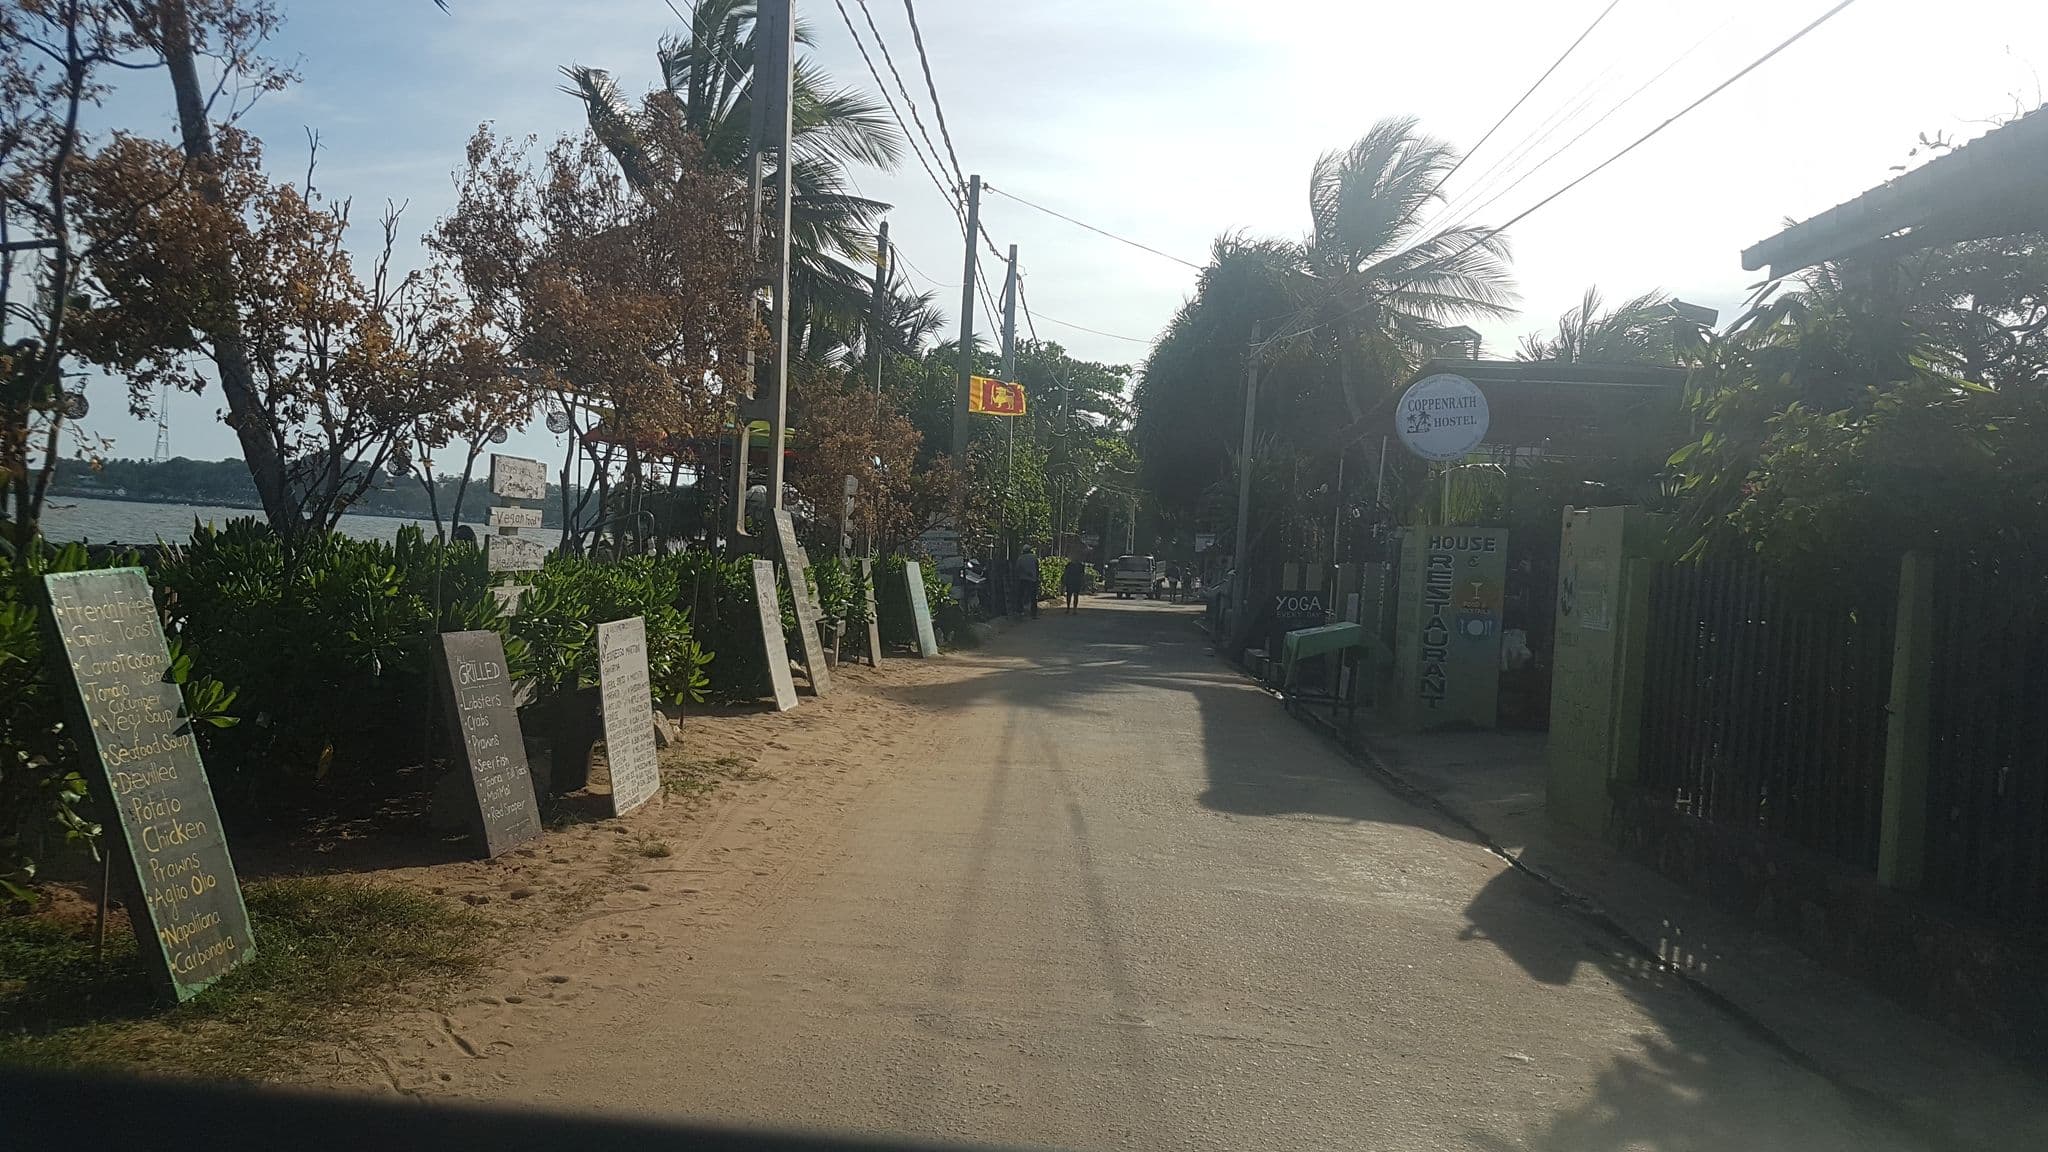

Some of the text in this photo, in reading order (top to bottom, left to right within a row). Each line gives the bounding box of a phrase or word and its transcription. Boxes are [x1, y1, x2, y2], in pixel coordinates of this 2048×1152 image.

[1408, 396, 1477, 412] COPPENRATH
[1434, 416, 1477, 427] HOSTEL
[1430, 536, 1496, 552] HOUSE
[62, 590, 155, 623] French Fries
[1276, 595, 1321, 611] YOGA
[112, 616, 157, 642] Toast
[78, 650, 126, 677] Carrot
[459, 662, 501, 685] GRILLED
[86, 678, 129, 703] Tomato
[461, 691, 502, 711] Lobsters
[145, 706, 175, 728] Soup
[467, 714, 490, 731] Crabs
[108, 731, 189, 766] Seafood Soup
[117, 756, 178, 794] Devilled
[132, 790, 182, 824] Potato
[142, 818, 208, 853] Chicken
[150, 853, 201, 882] Prawns
[154, 872, 216, 921] Aglio Olio
[165, 906, 221, 949] Napolitana
[174, 935, 236, 975] Carbonara
